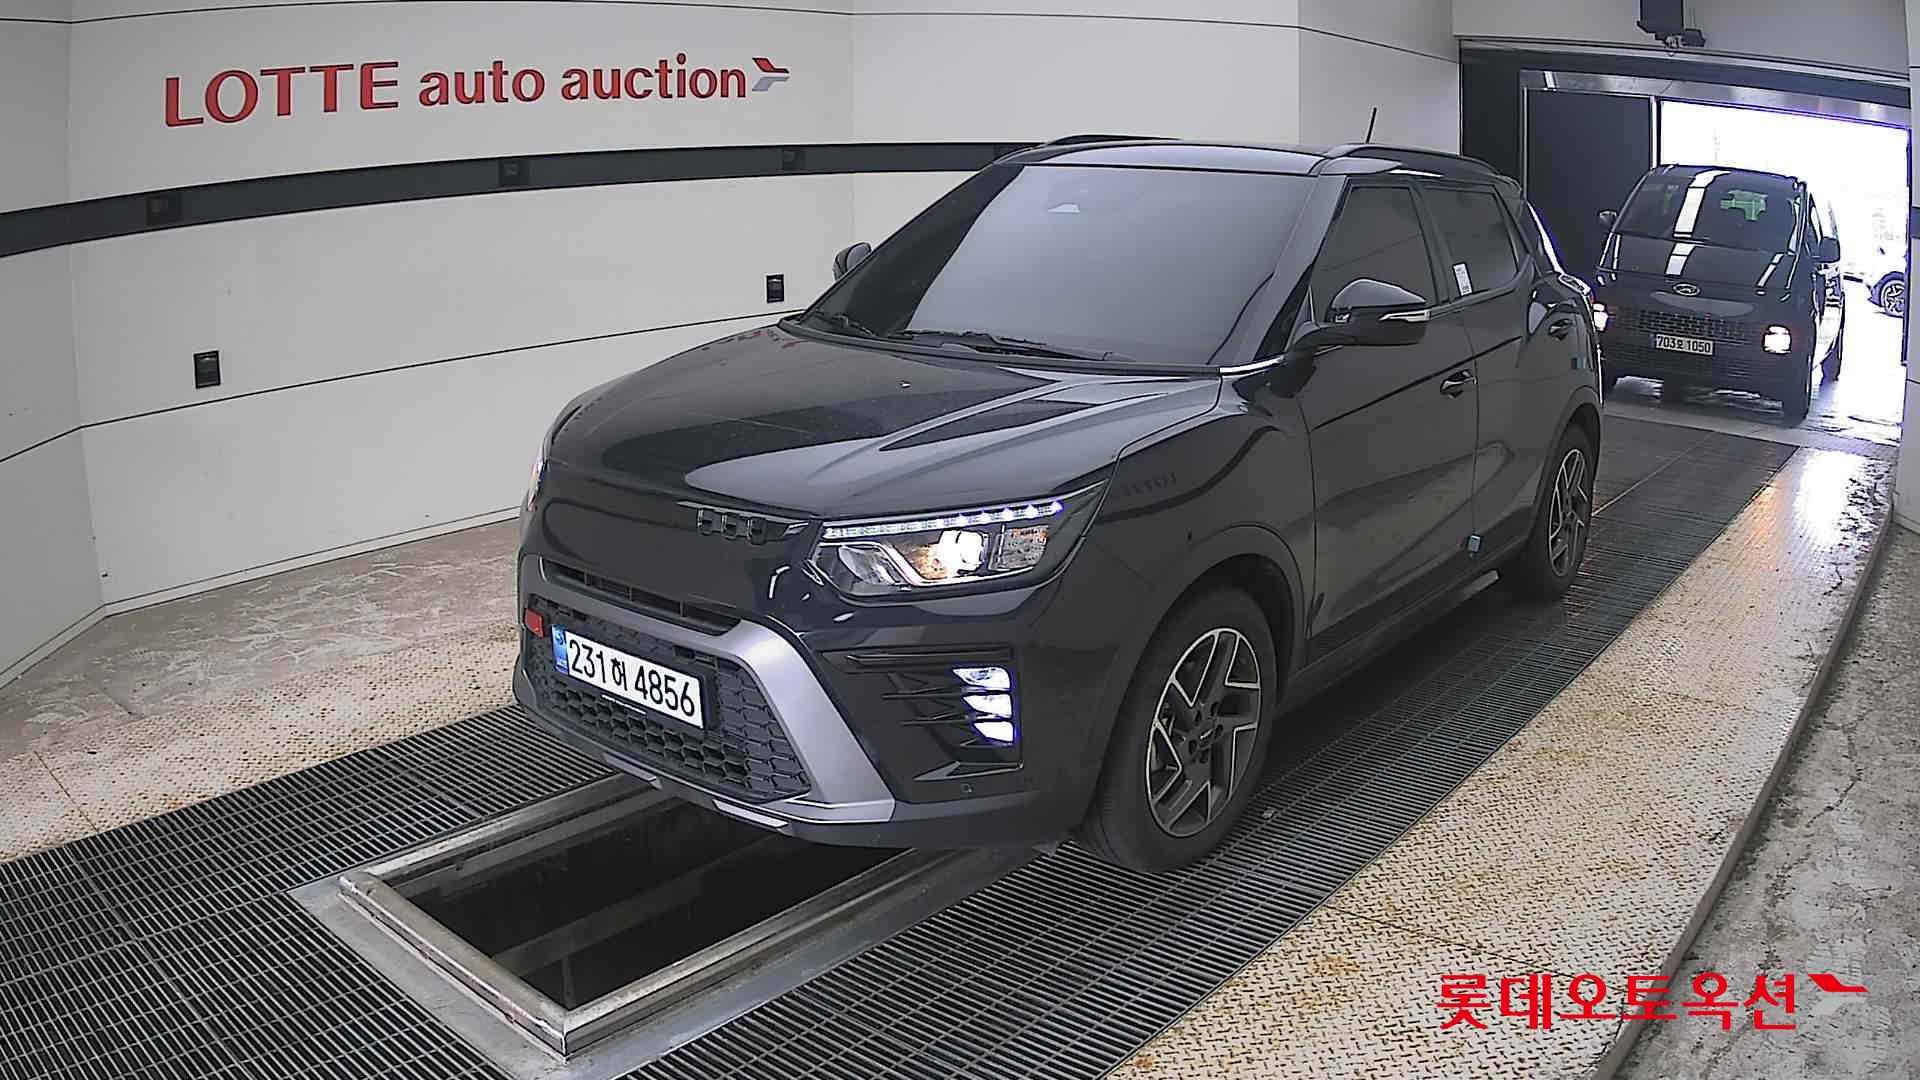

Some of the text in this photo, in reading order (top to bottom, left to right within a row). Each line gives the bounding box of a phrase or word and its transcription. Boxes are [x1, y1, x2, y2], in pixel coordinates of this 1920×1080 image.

[165, 52, 747, 127] LOTTE auto auction
[1687, 339, 1711, 353] 1050
[569, 639, 696, 717] 231허 4856
